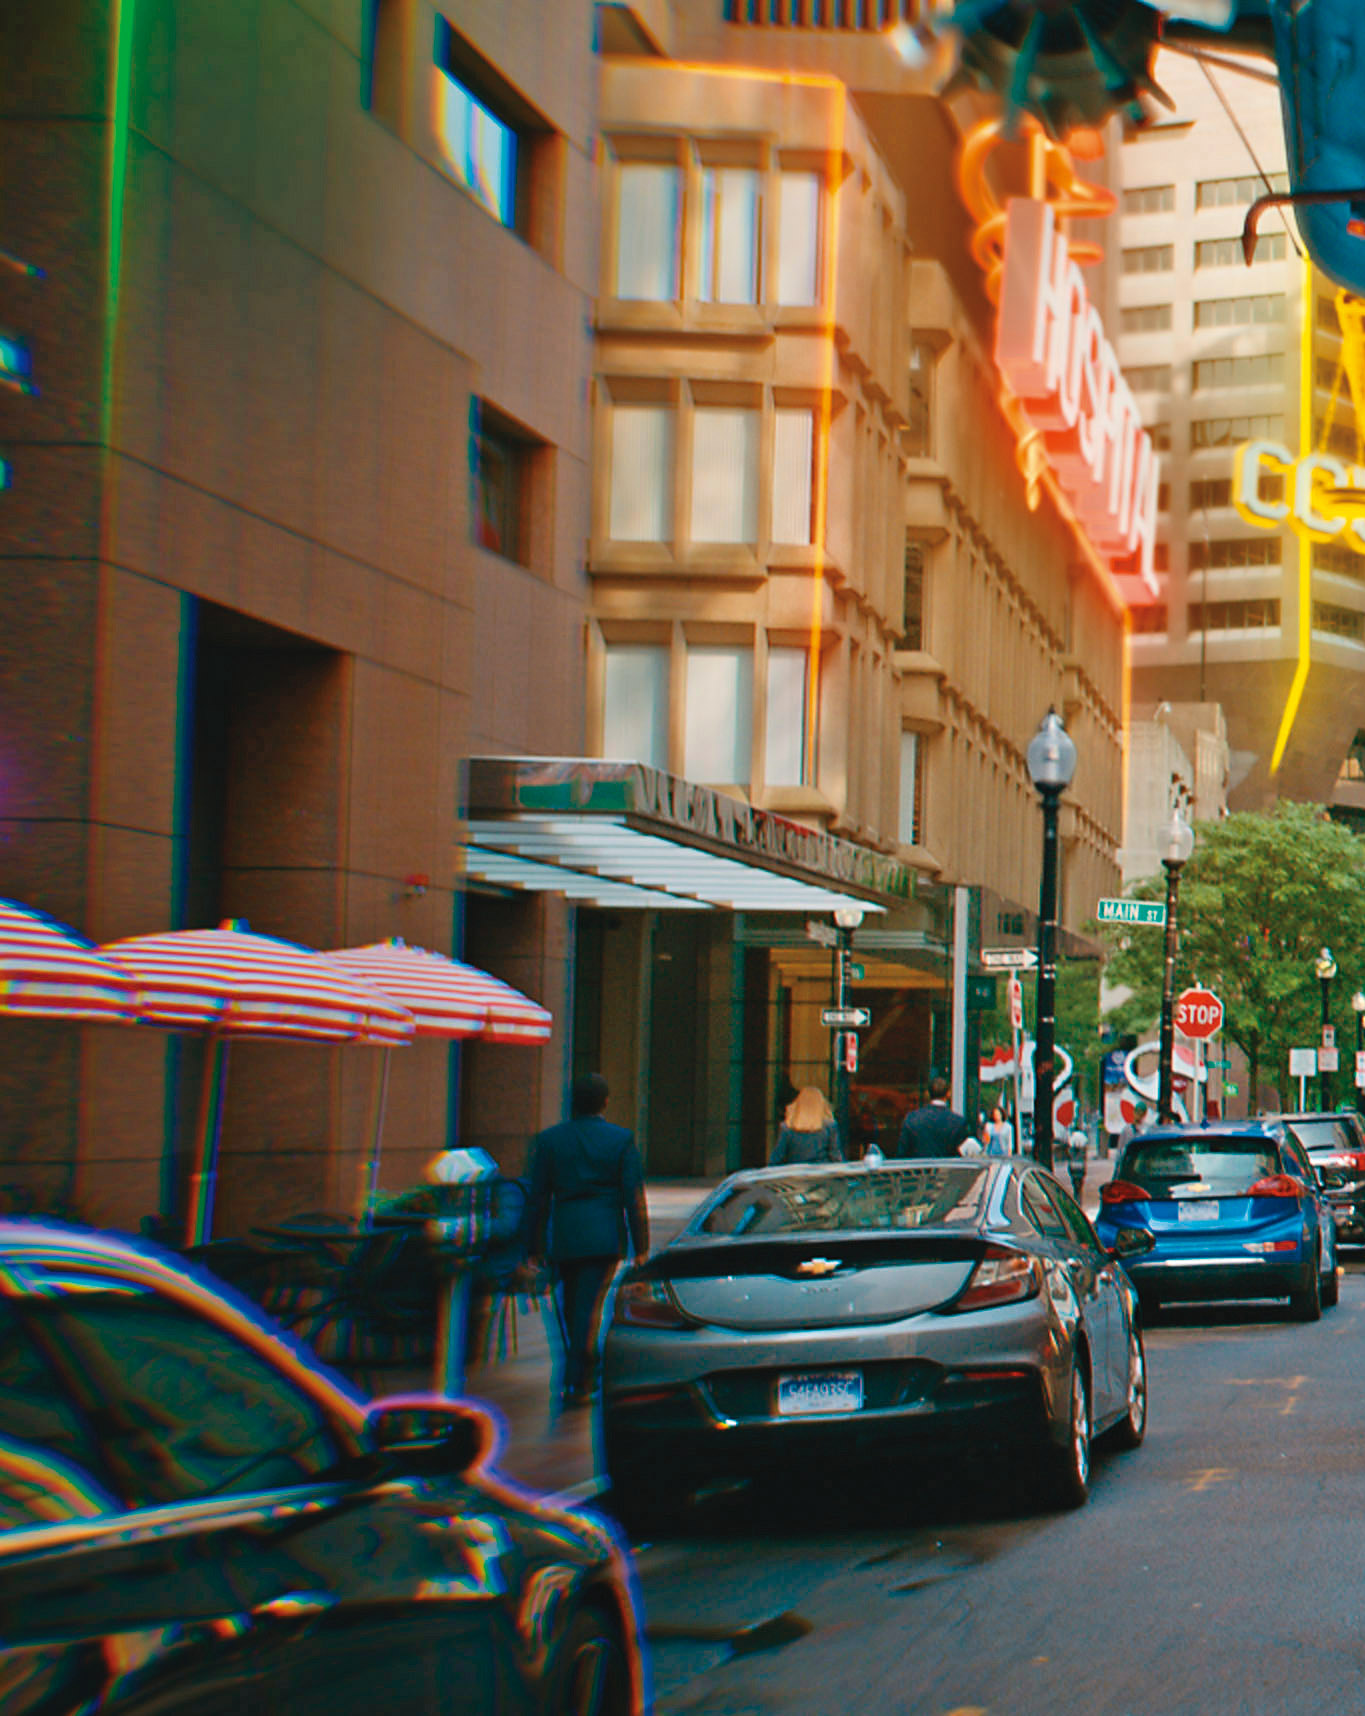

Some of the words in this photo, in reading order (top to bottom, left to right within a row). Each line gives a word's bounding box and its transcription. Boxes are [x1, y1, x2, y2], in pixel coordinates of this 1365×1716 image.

[1032, 202, 1160, 598] HOSPITAL
[1103, 903, 1139, 920] MAIN
[1147, 910, 1158, 921] ST
[1178, 1005, 1220, 1024] STOP
